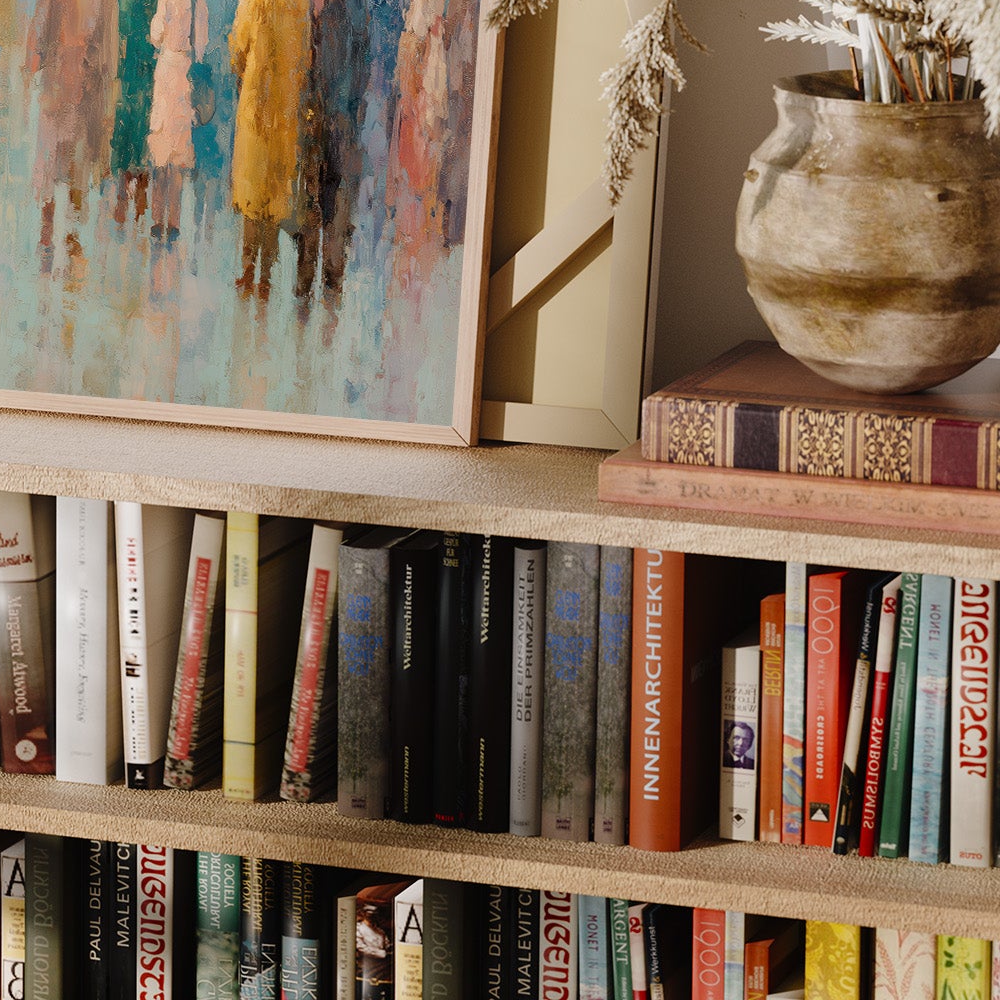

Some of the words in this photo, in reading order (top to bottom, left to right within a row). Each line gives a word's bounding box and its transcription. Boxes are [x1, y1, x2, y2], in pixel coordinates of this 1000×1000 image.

[6, 596, 25, 656] Margaret
[403, 564, 413, 670] Weltarchitektur
[516, 574, 526, 686] EINSAMKEIT
[524, 558, 535, 679] PRIMZAHLEN
[13, 661, 32, 714] Atwood
[524, 685, 532, 722] DER
[89, 840, 102, 910] DELVAU
[89, 916, 101, 961] PAUL
[488, 885, 502, 957] DELVAU
[586, 914, 599, 952] MONET
[650, 926, 660, 974] Werkkunst
[694, 921, 720, 987] 1900
